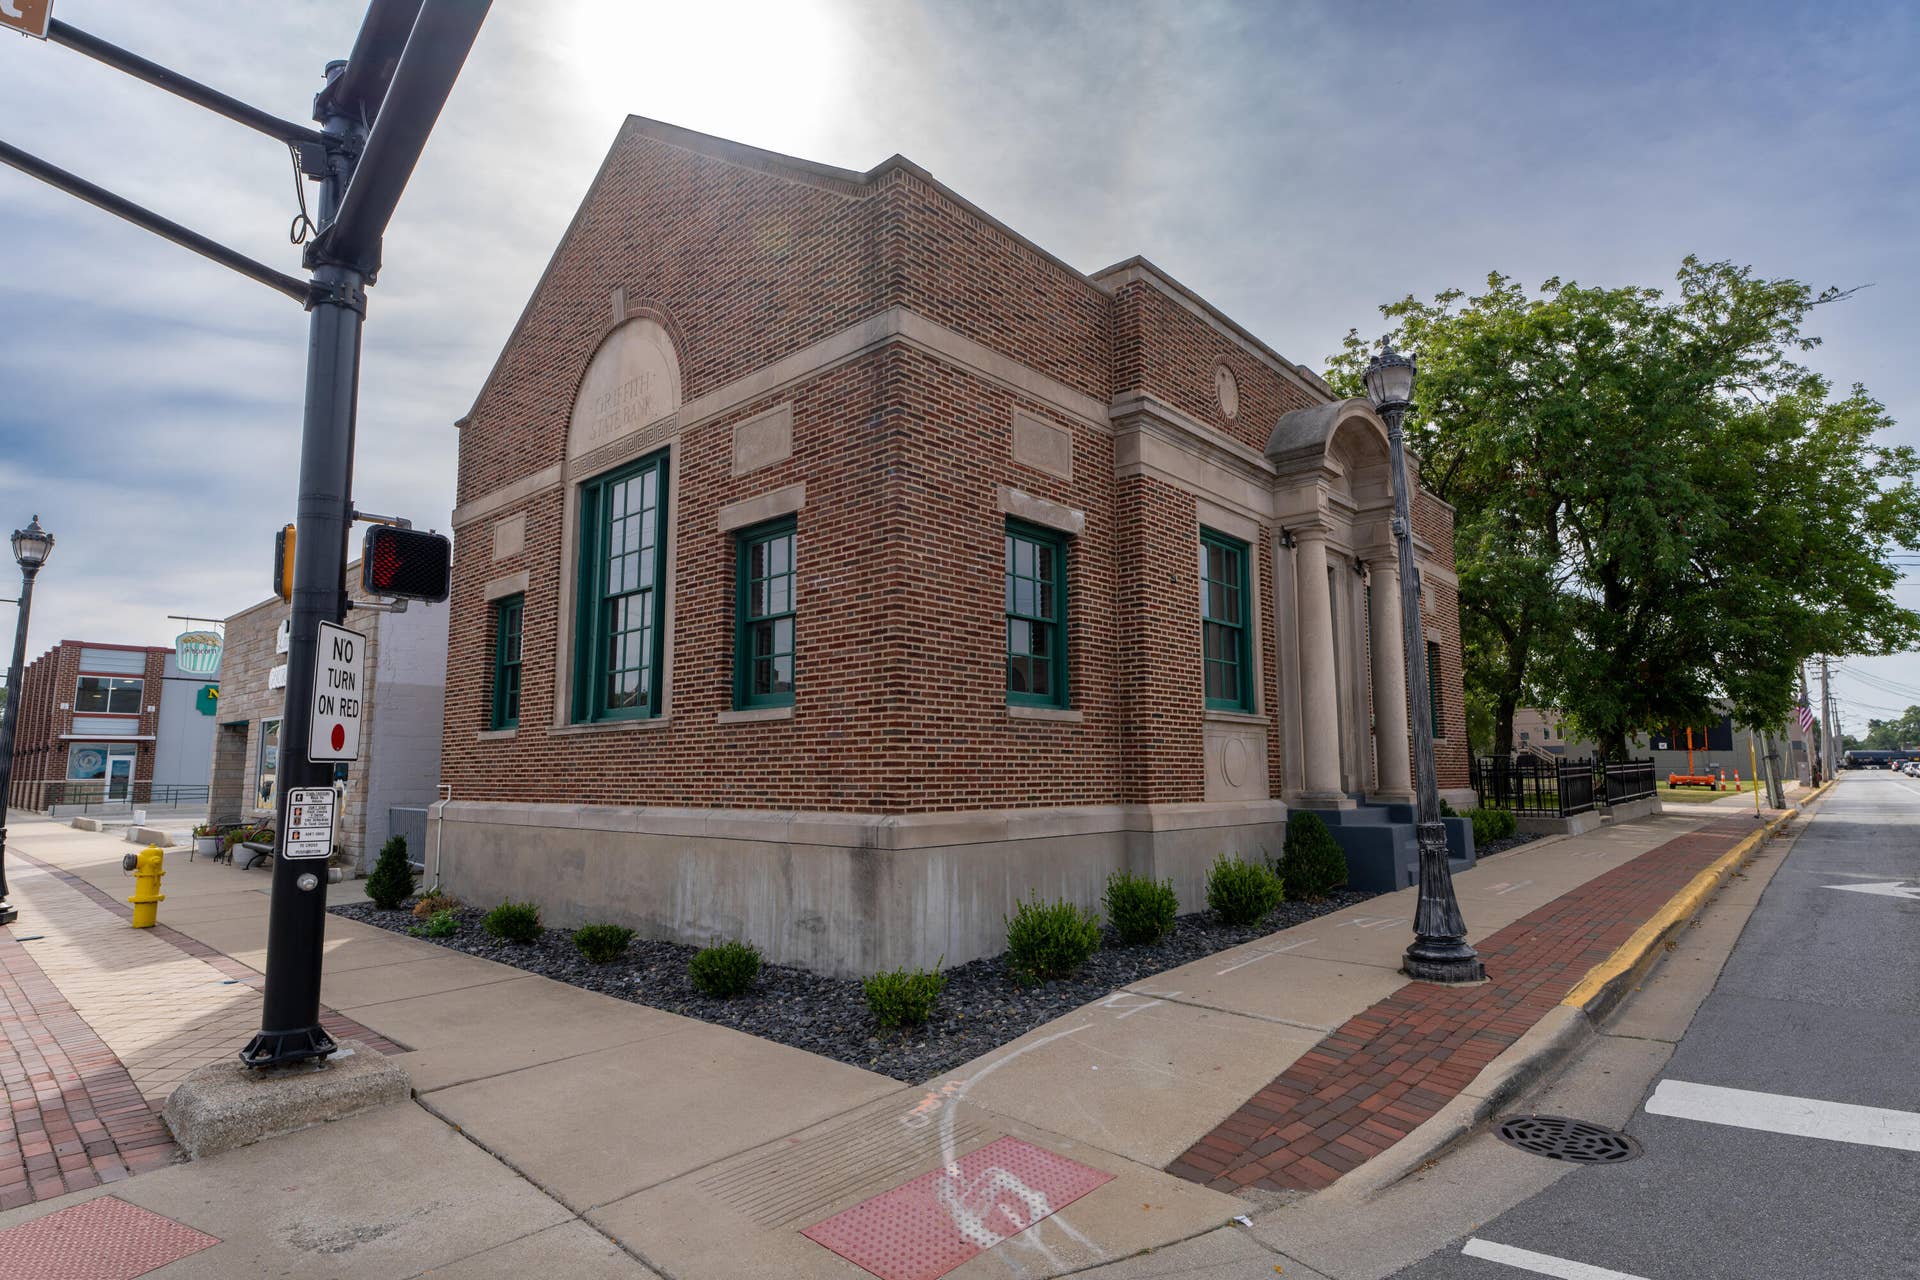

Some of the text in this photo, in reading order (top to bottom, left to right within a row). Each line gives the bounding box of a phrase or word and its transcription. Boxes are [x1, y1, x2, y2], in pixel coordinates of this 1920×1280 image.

[594, 371, 650, 415] GRIFFITH
[591, 395, 652, 440] STATE BANK
[333, 636, 353, 663] NO
[328, 668, 355, 691] TURN
[318, 695, 359, 718] ON RED
